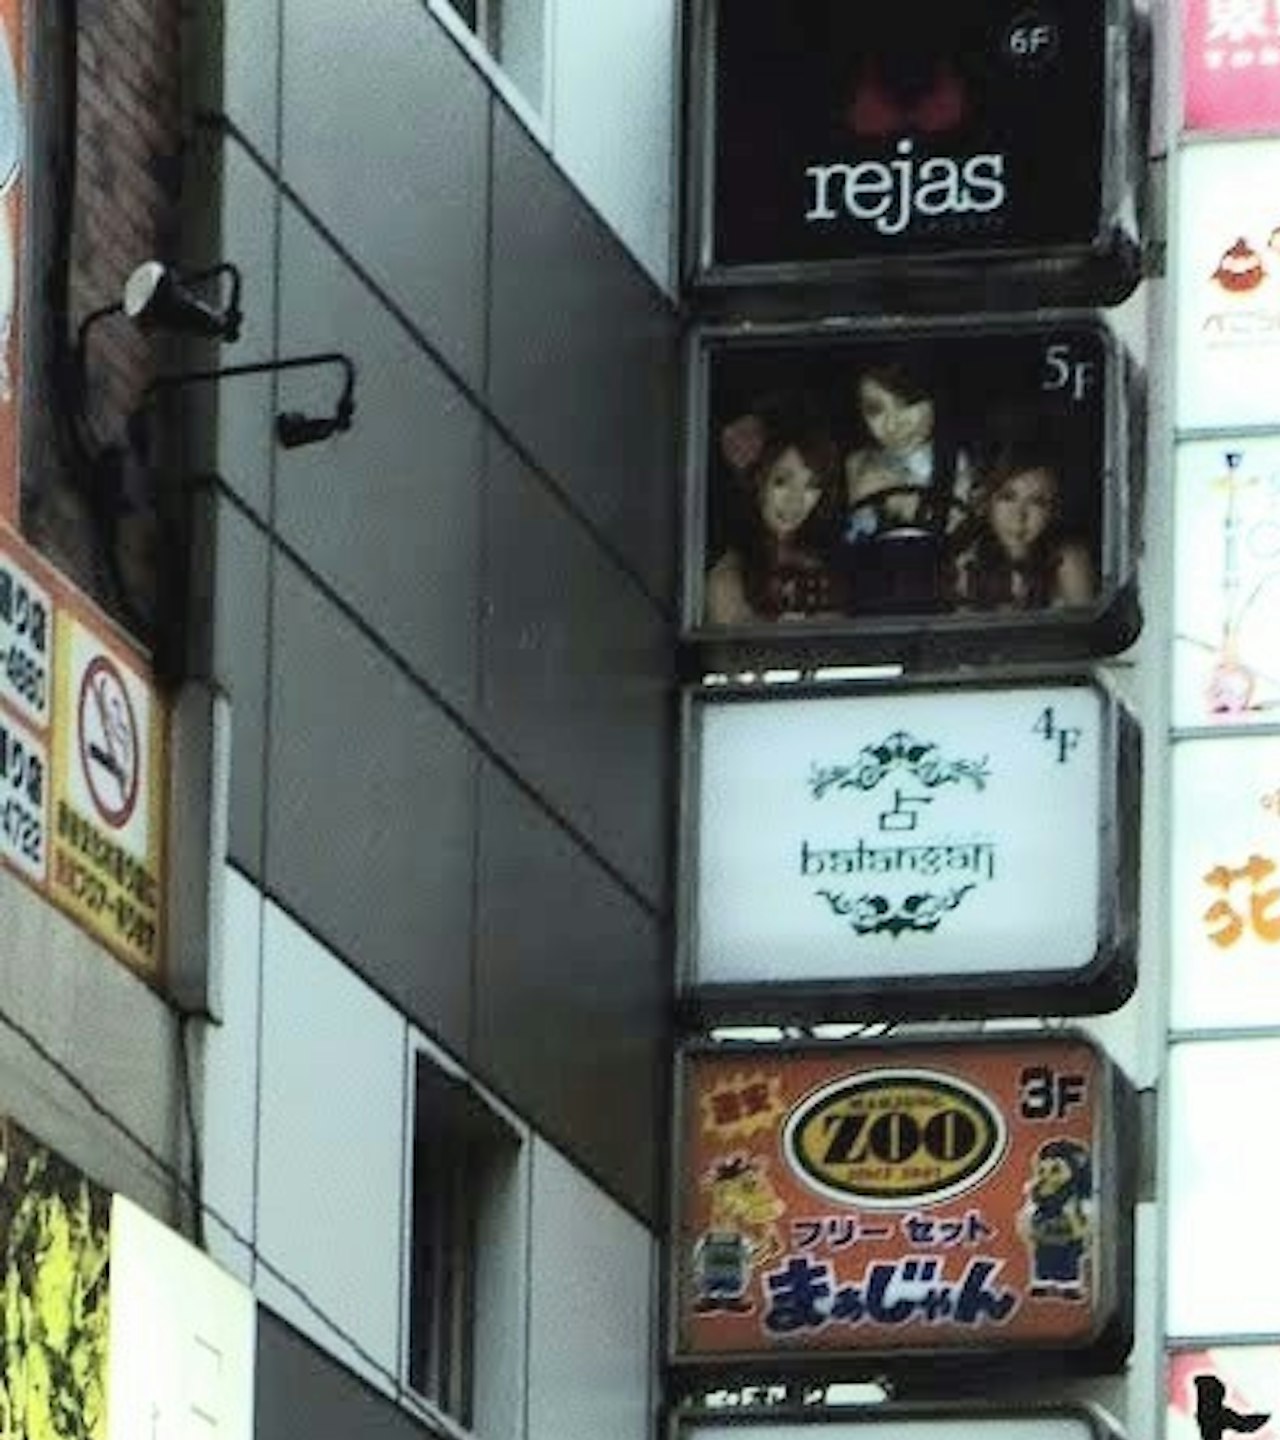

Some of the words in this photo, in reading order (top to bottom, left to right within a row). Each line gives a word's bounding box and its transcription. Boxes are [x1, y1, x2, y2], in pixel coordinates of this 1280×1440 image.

[1008, 26, 1052, 55] 6F
[805, 139, 1006, 235] rejas
[1042, 345, 1095, 399] 5F
[822, 1109, 977, 1166] ZOO
